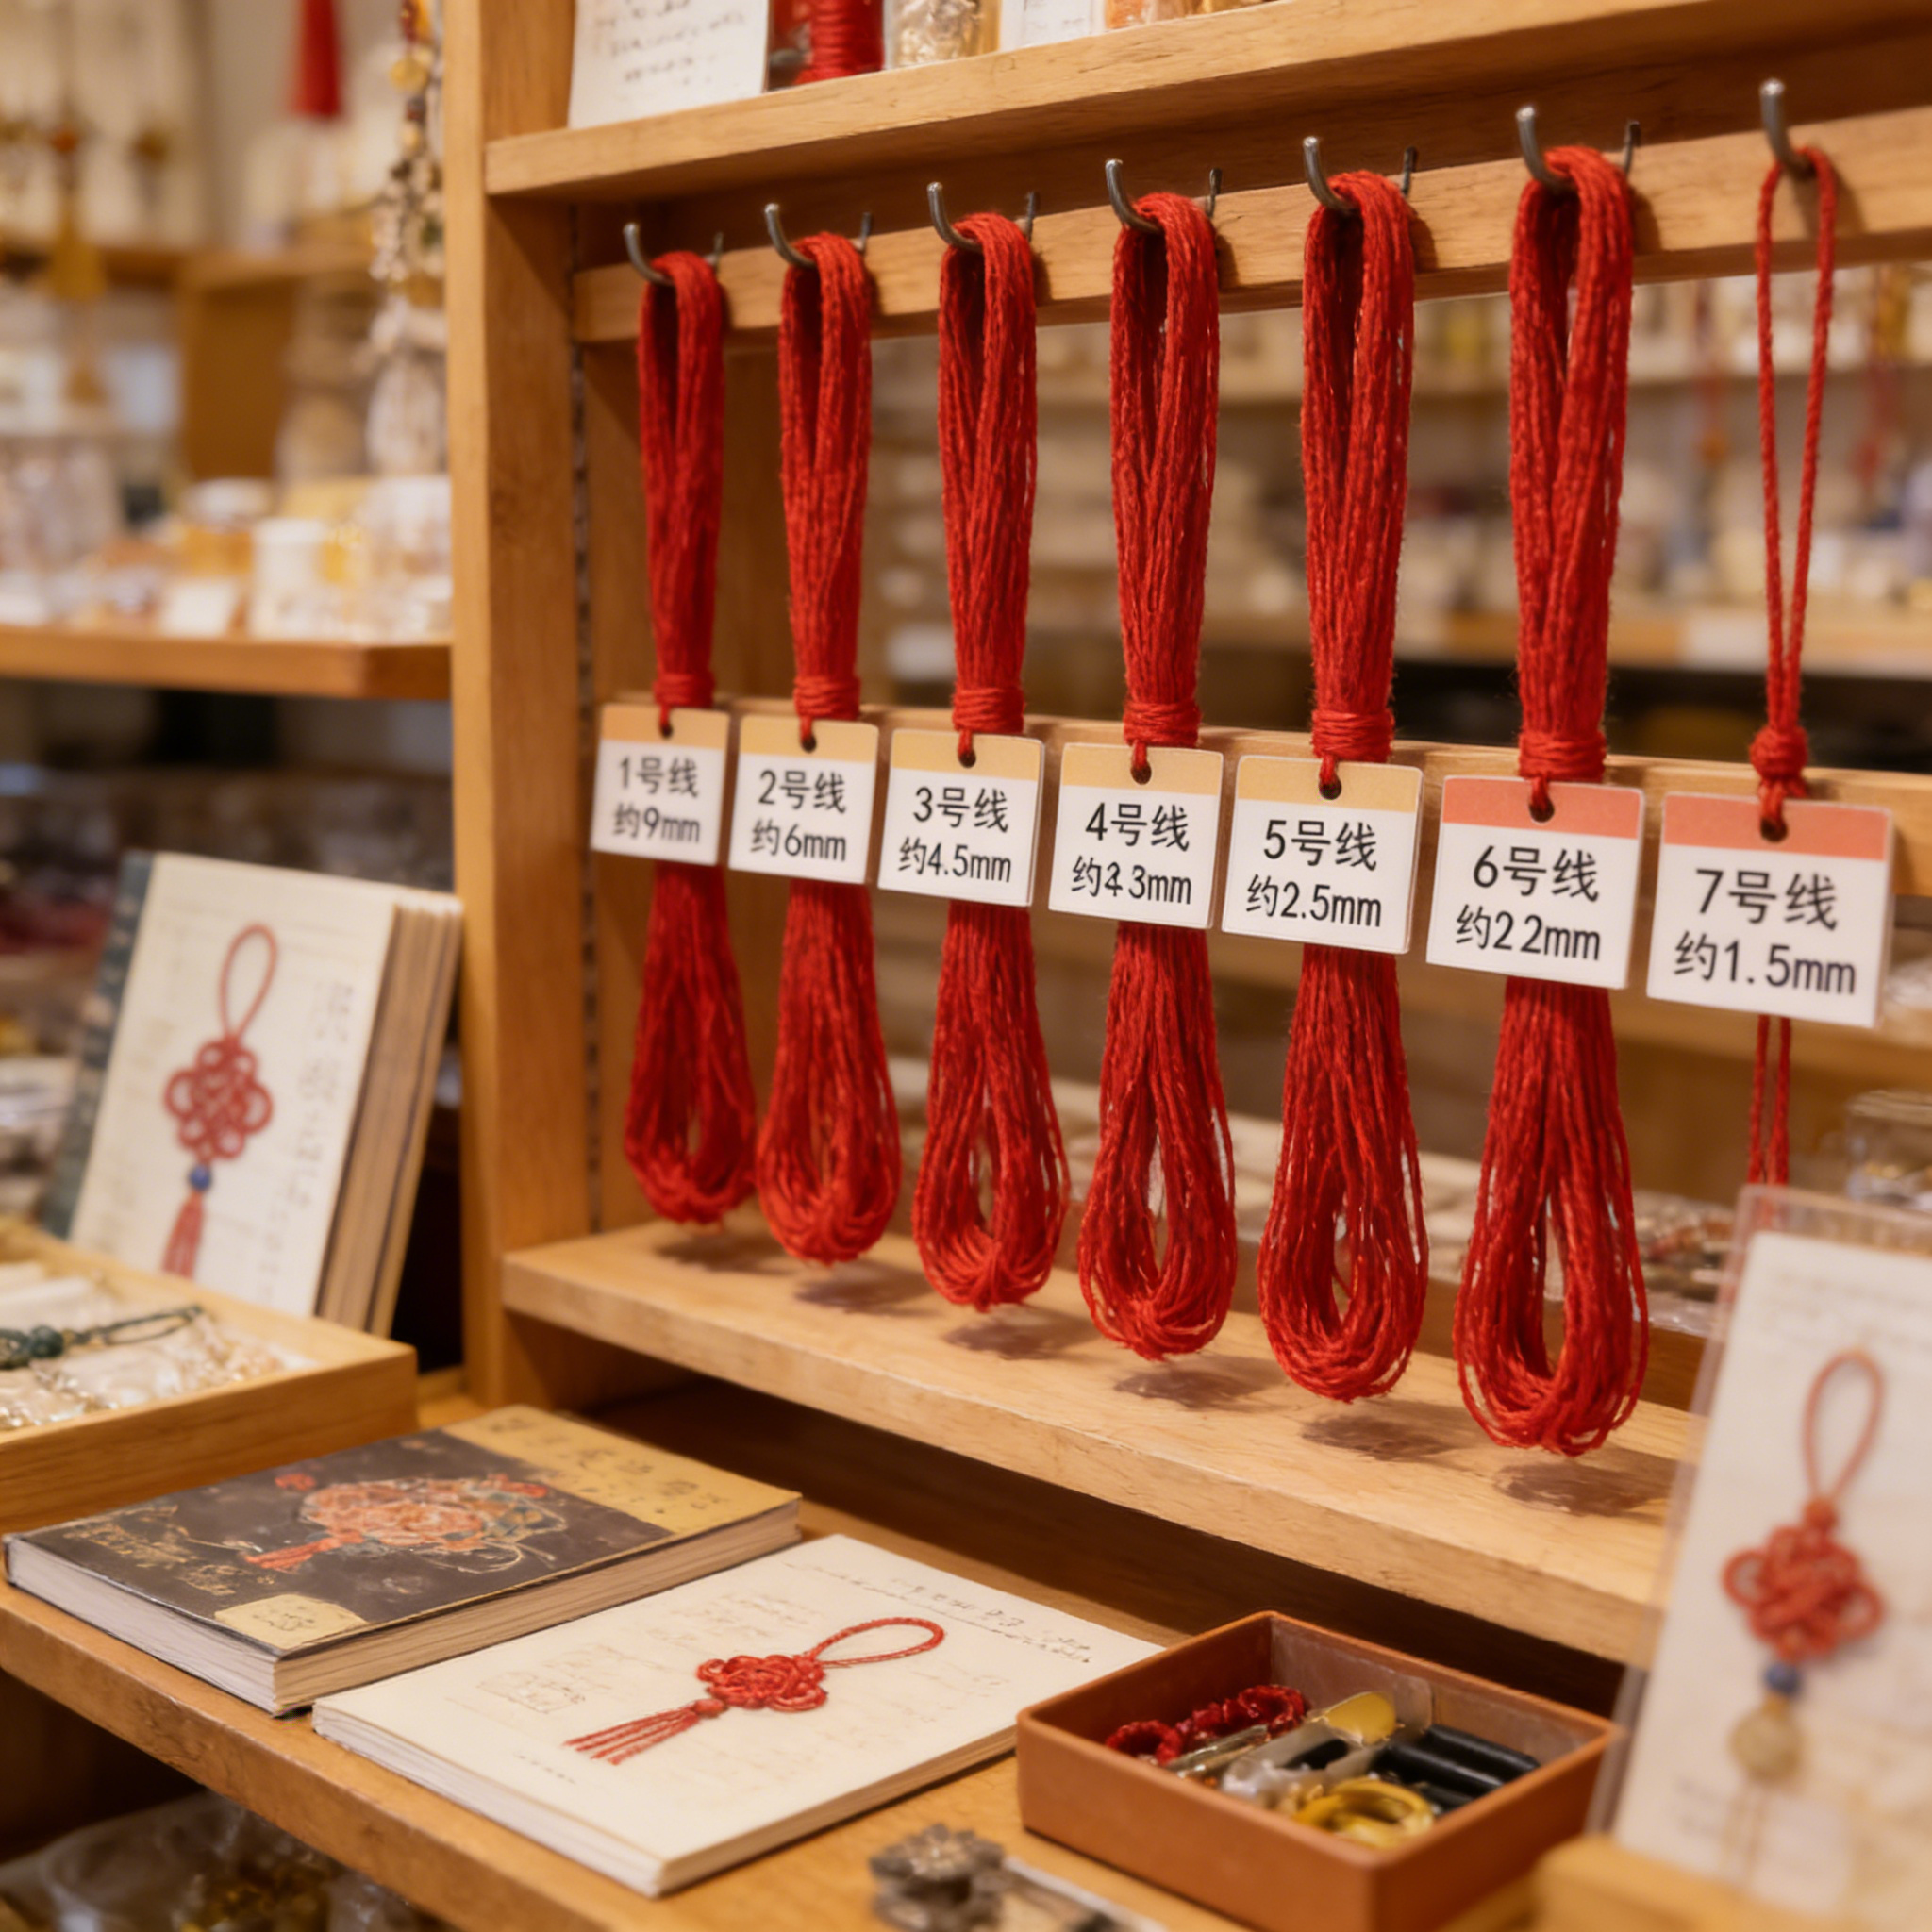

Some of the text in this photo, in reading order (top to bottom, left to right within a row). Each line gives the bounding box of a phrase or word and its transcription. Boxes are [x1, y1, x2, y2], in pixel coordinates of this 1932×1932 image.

[620, 757, 699, 799] 1号线
[758, 768, 847, 815] 2号线
[613, 803, 701, 842] 约9mm
[912, 785, 1009, 834] 3号线
[1084, 801, 1190, 853] 4号线
[750, 819, 847, 862] 约6mm
[897, 836, 1012, 884] 约4.5mm
[1263, 818, 1377, 872] 5号线
[1473, 844, 1600, 903] 6号线
[1245, 873, 1382, 928] 约2.5mm
[1695, 868, 1839, 932] 7号线
[1673, 931, 1857, 995] 约1.5mm
